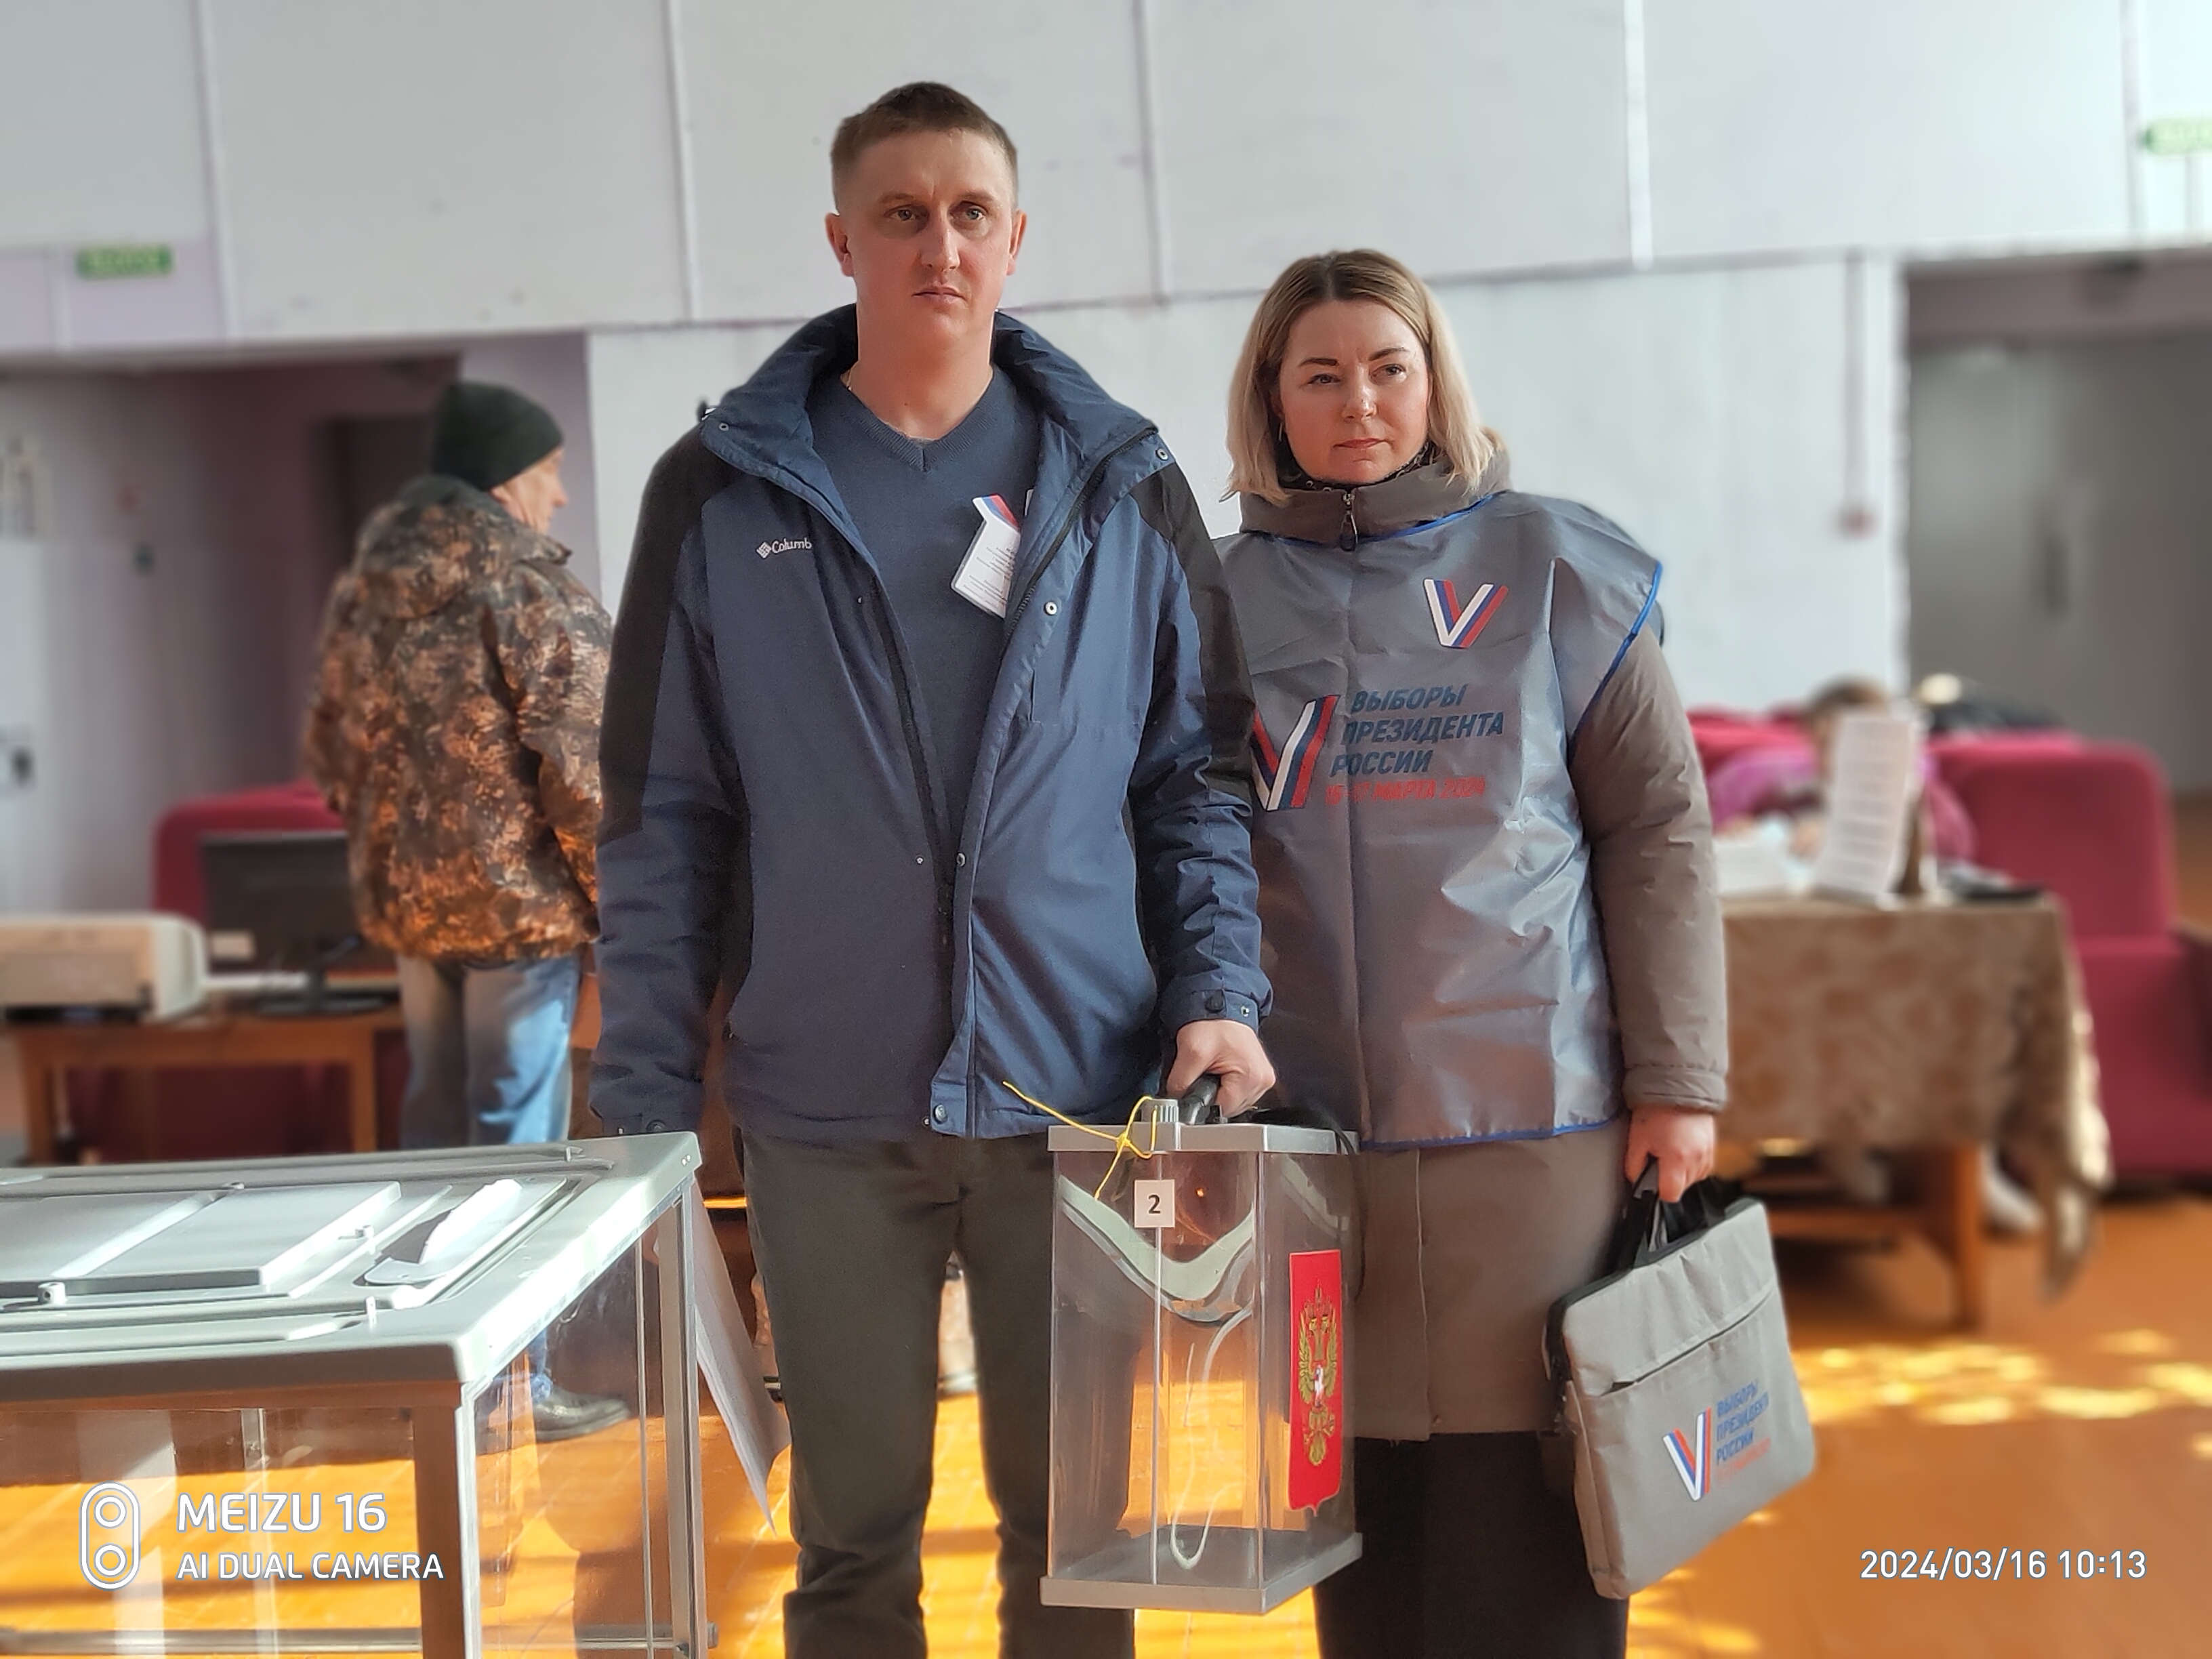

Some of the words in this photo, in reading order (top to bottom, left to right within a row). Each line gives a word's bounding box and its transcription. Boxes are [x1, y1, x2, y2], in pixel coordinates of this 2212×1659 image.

[1350, 684, 1469, 714] ВЫБОРЫ
[1342, 712, 1504, 745] ПРЕЗИДЕНТА
[1329, 750, 1434, 778] РОССИИ
[1148, 1194, 1161, 1214] 2
